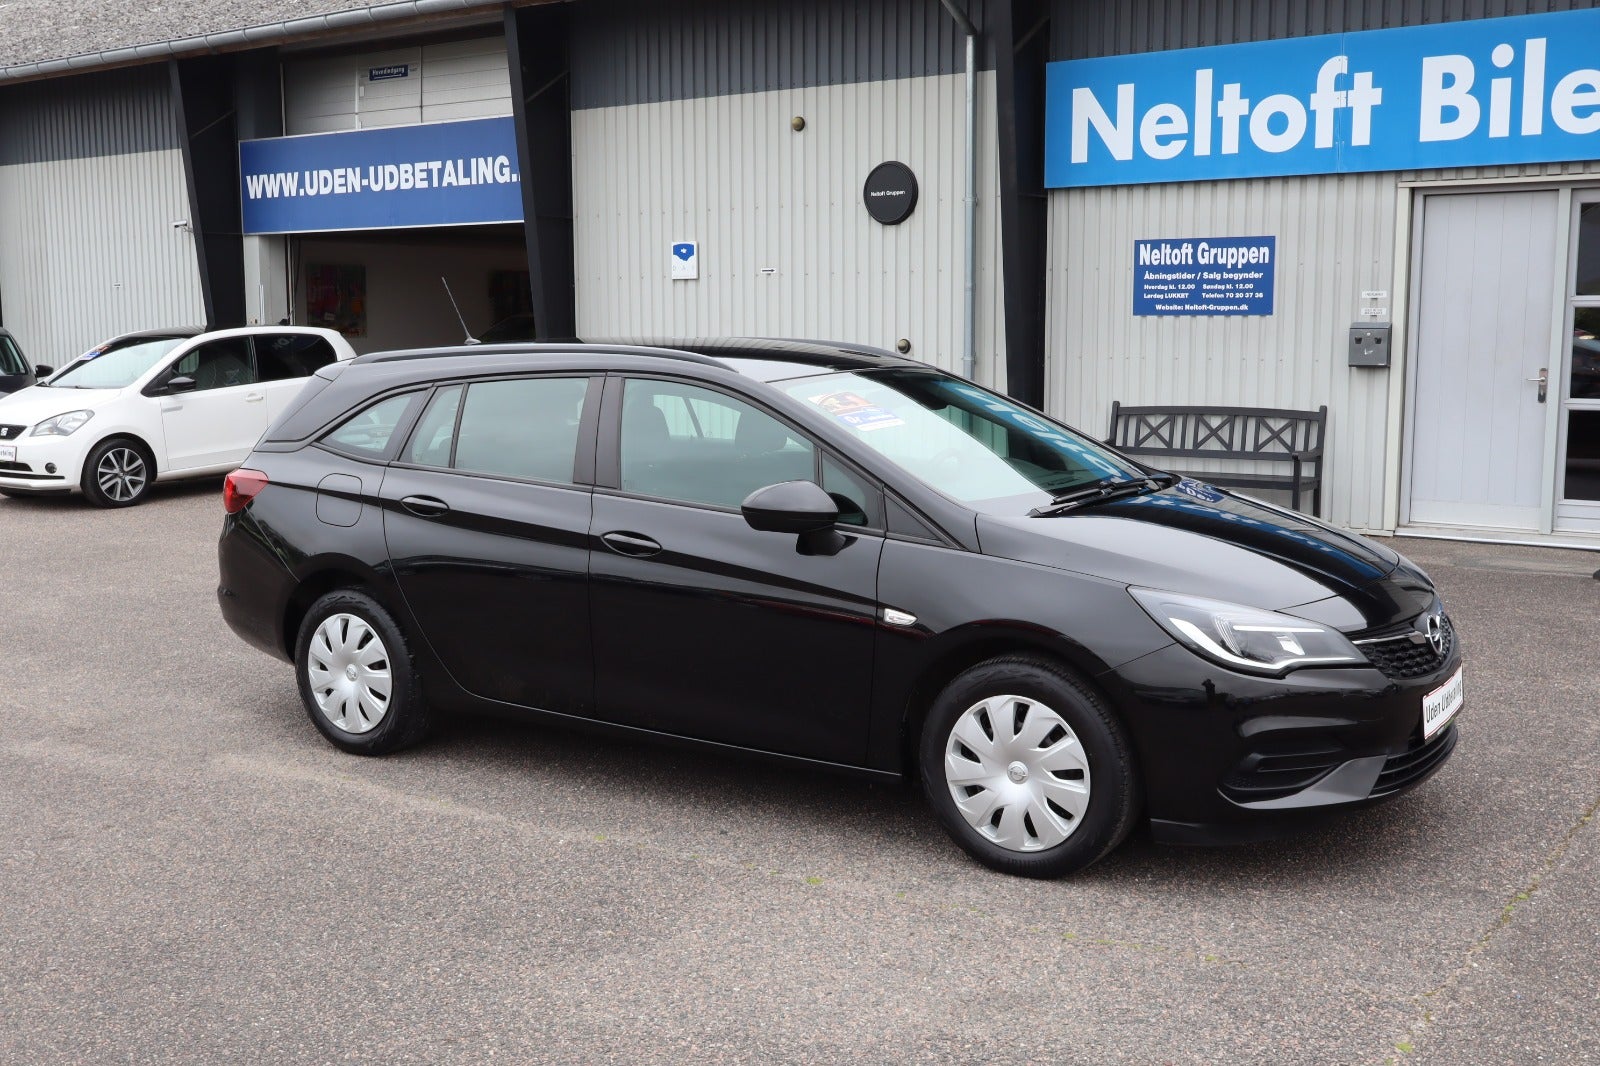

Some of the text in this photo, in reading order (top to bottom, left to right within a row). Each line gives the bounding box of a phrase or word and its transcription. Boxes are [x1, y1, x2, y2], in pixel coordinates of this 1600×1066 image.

[1071, 37, 1600, 163] Neltoft Bile
[246, 155, 521, 199] WWW.UDEN-UDBETALING.
[1139, 242, 1270, 268] Neltoft Gruppen
[1144, 270, 1196, 280] Åbningstider
[1202, 272, 1221, 280] Salg
[1223, 272, 1264, 280] begynder
[1426, 702, 1440, 724] Uden
